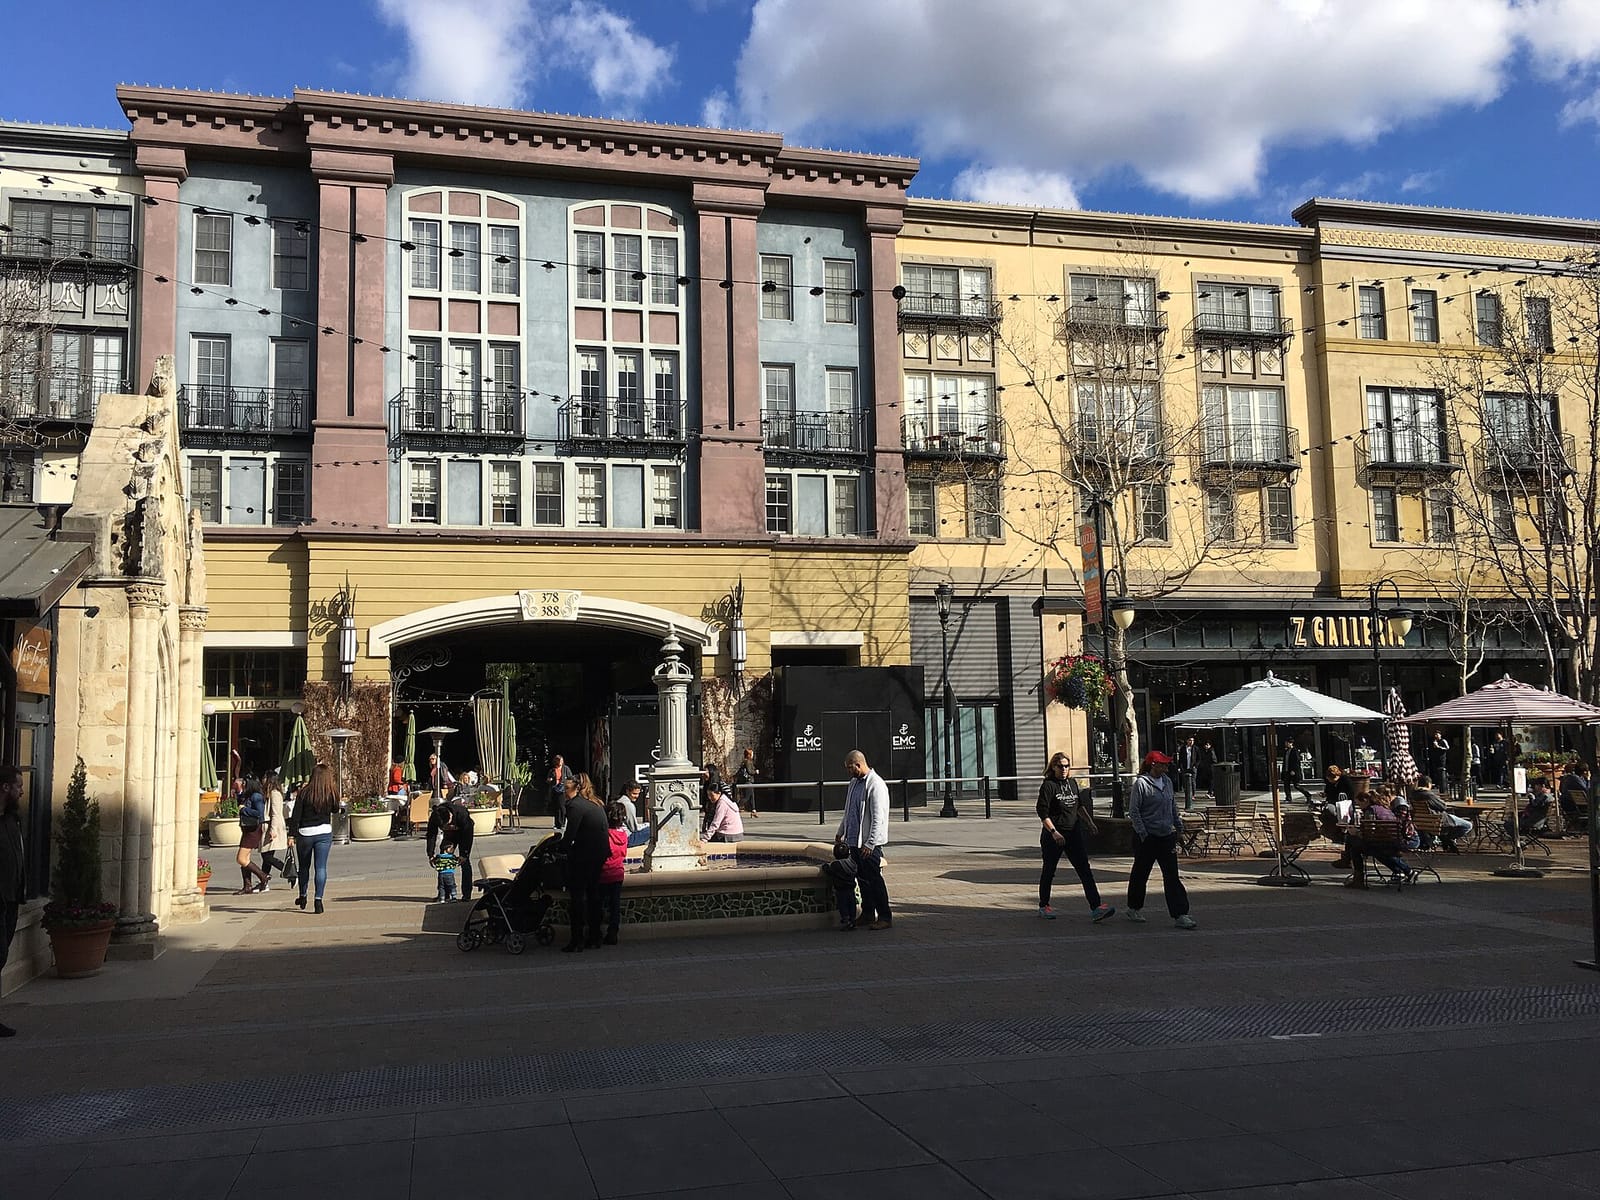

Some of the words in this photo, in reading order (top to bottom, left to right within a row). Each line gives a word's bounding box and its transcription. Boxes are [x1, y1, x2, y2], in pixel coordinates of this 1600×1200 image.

[541, 592, 559, 603] 378
[541, 605, 560, 617] 388
[1290, 617, 1307, 647] Z
[231, 700, 280, 711] VILLAGE
[796, 736, 822, 748] EMC
[892, 735, 916, 746] EMC
